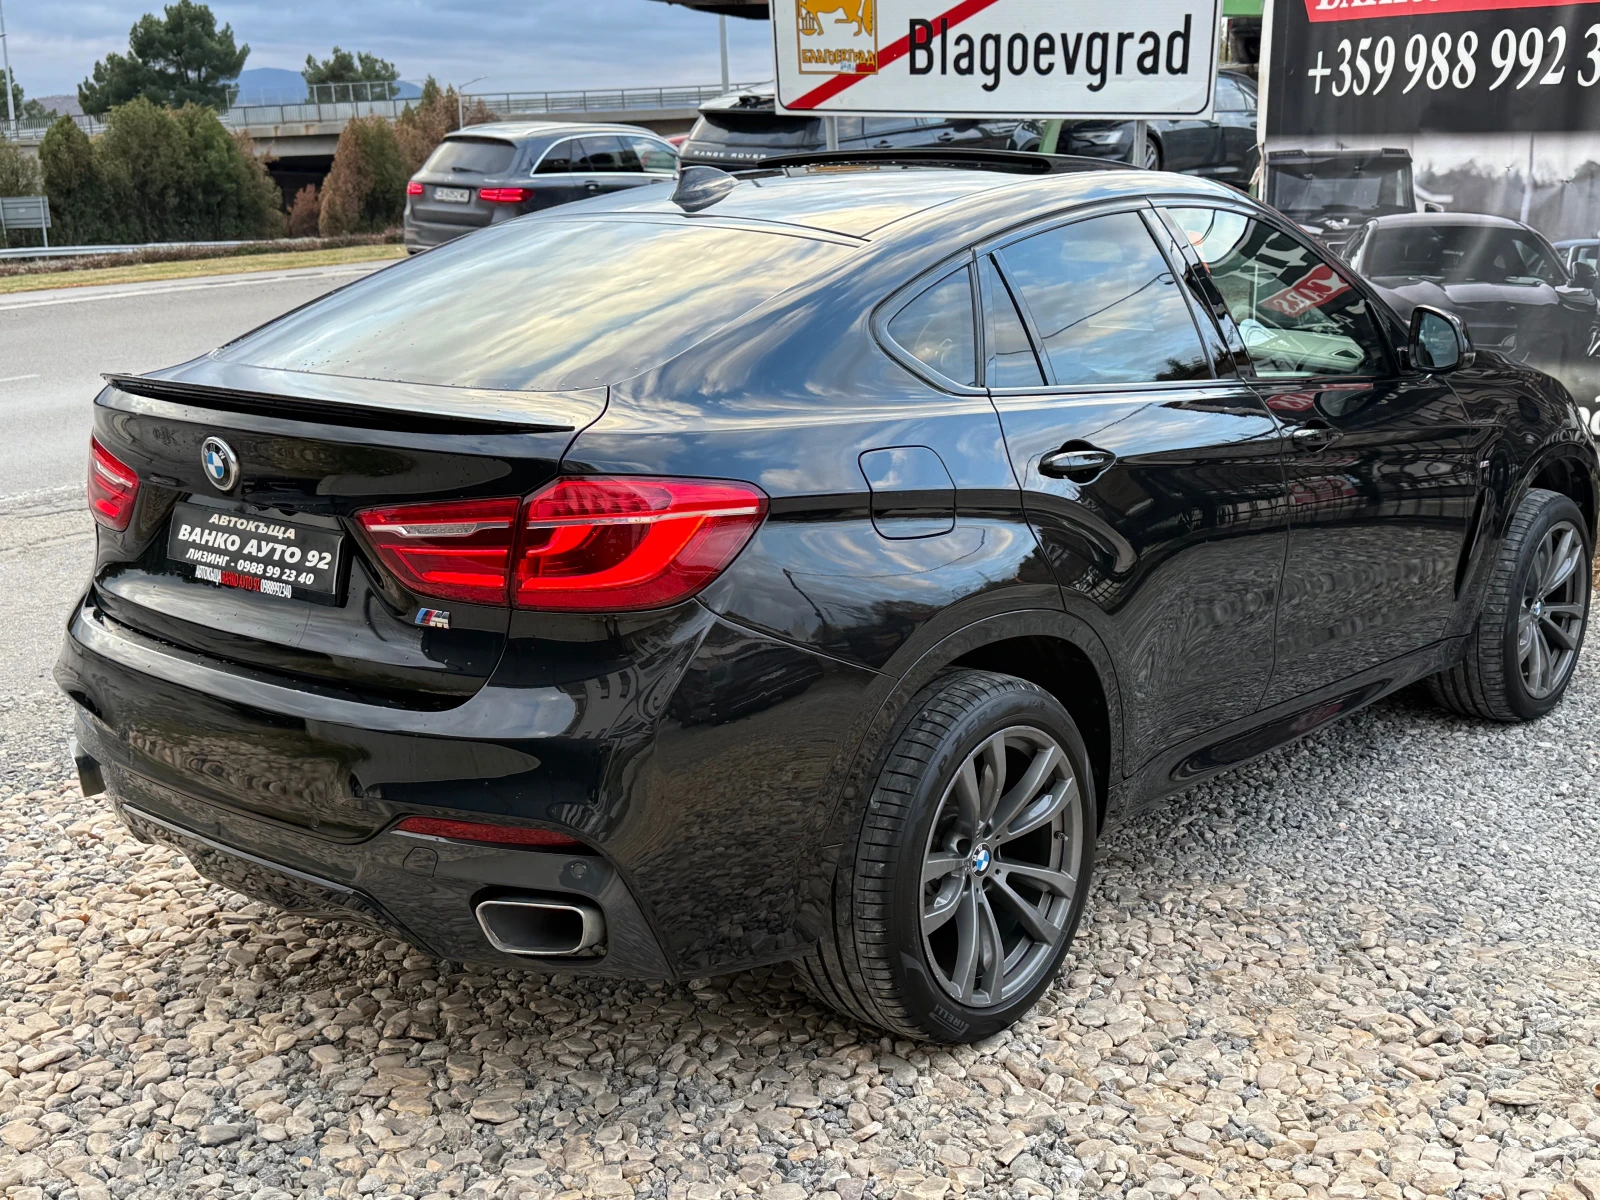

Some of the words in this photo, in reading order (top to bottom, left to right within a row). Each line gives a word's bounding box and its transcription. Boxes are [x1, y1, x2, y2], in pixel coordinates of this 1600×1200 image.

[909, 14, 1192, 92] Blagoevgrad
[1308, 36, 1395, 97] +359
[1402, 30, 1478, 95] 988
[1489, 26, 1566, 91] 992
[178, 524, 241, 551] ВАНКО
[243, 539, 302, 563] АУТО
[305, 550, 332, 570] 92
[209, 514, 296, 540] АВТОКЪЩА
[186, 548, 230, 567] ЛИЗИНГ
[237, 559, 263, 576] 0988
[265, 565, 281, 579] 99
[282, 568, 296, 582] 23
[298, 572, 314, 585] 40
